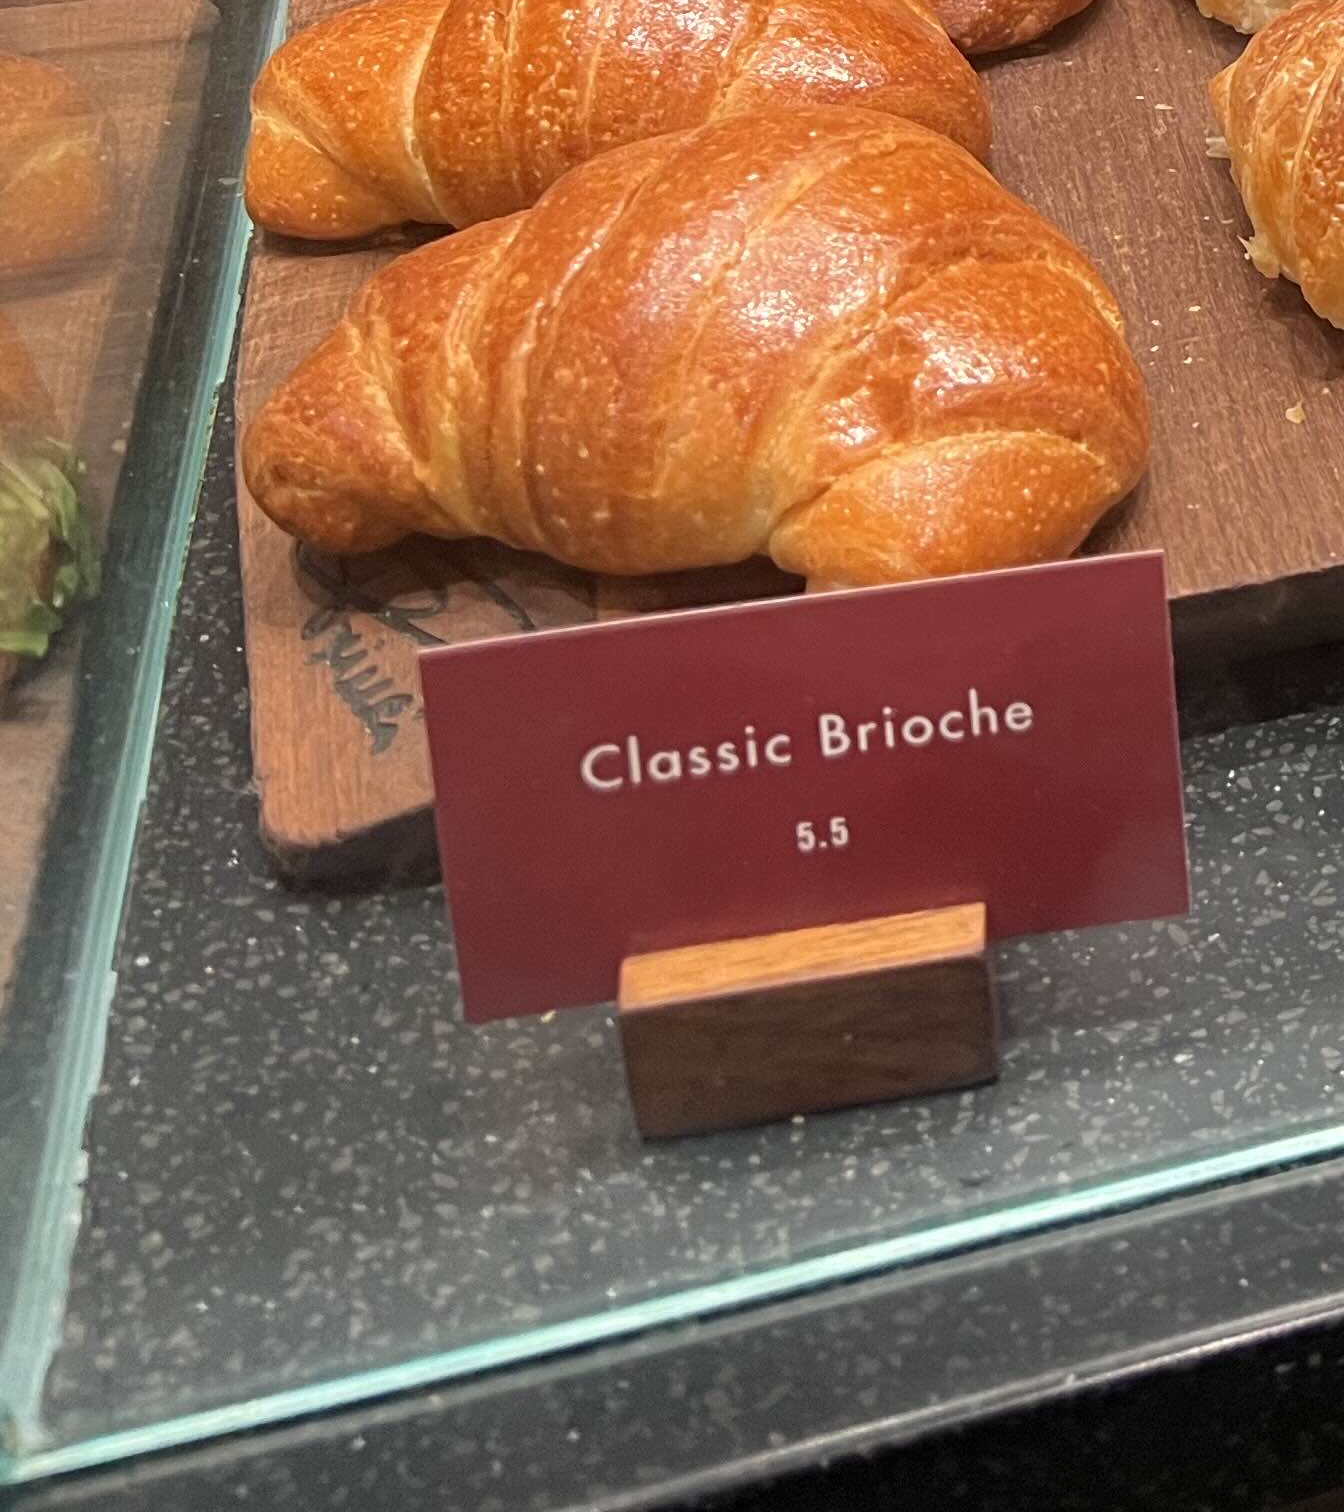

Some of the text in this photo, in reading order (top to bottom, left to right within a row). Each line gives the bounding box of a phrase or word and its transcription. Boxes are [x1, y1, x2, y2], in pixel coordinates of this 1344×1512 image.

[581, 687, 1034, 791] Classic Brioche
[796, 816, 850, 852] 5.5
